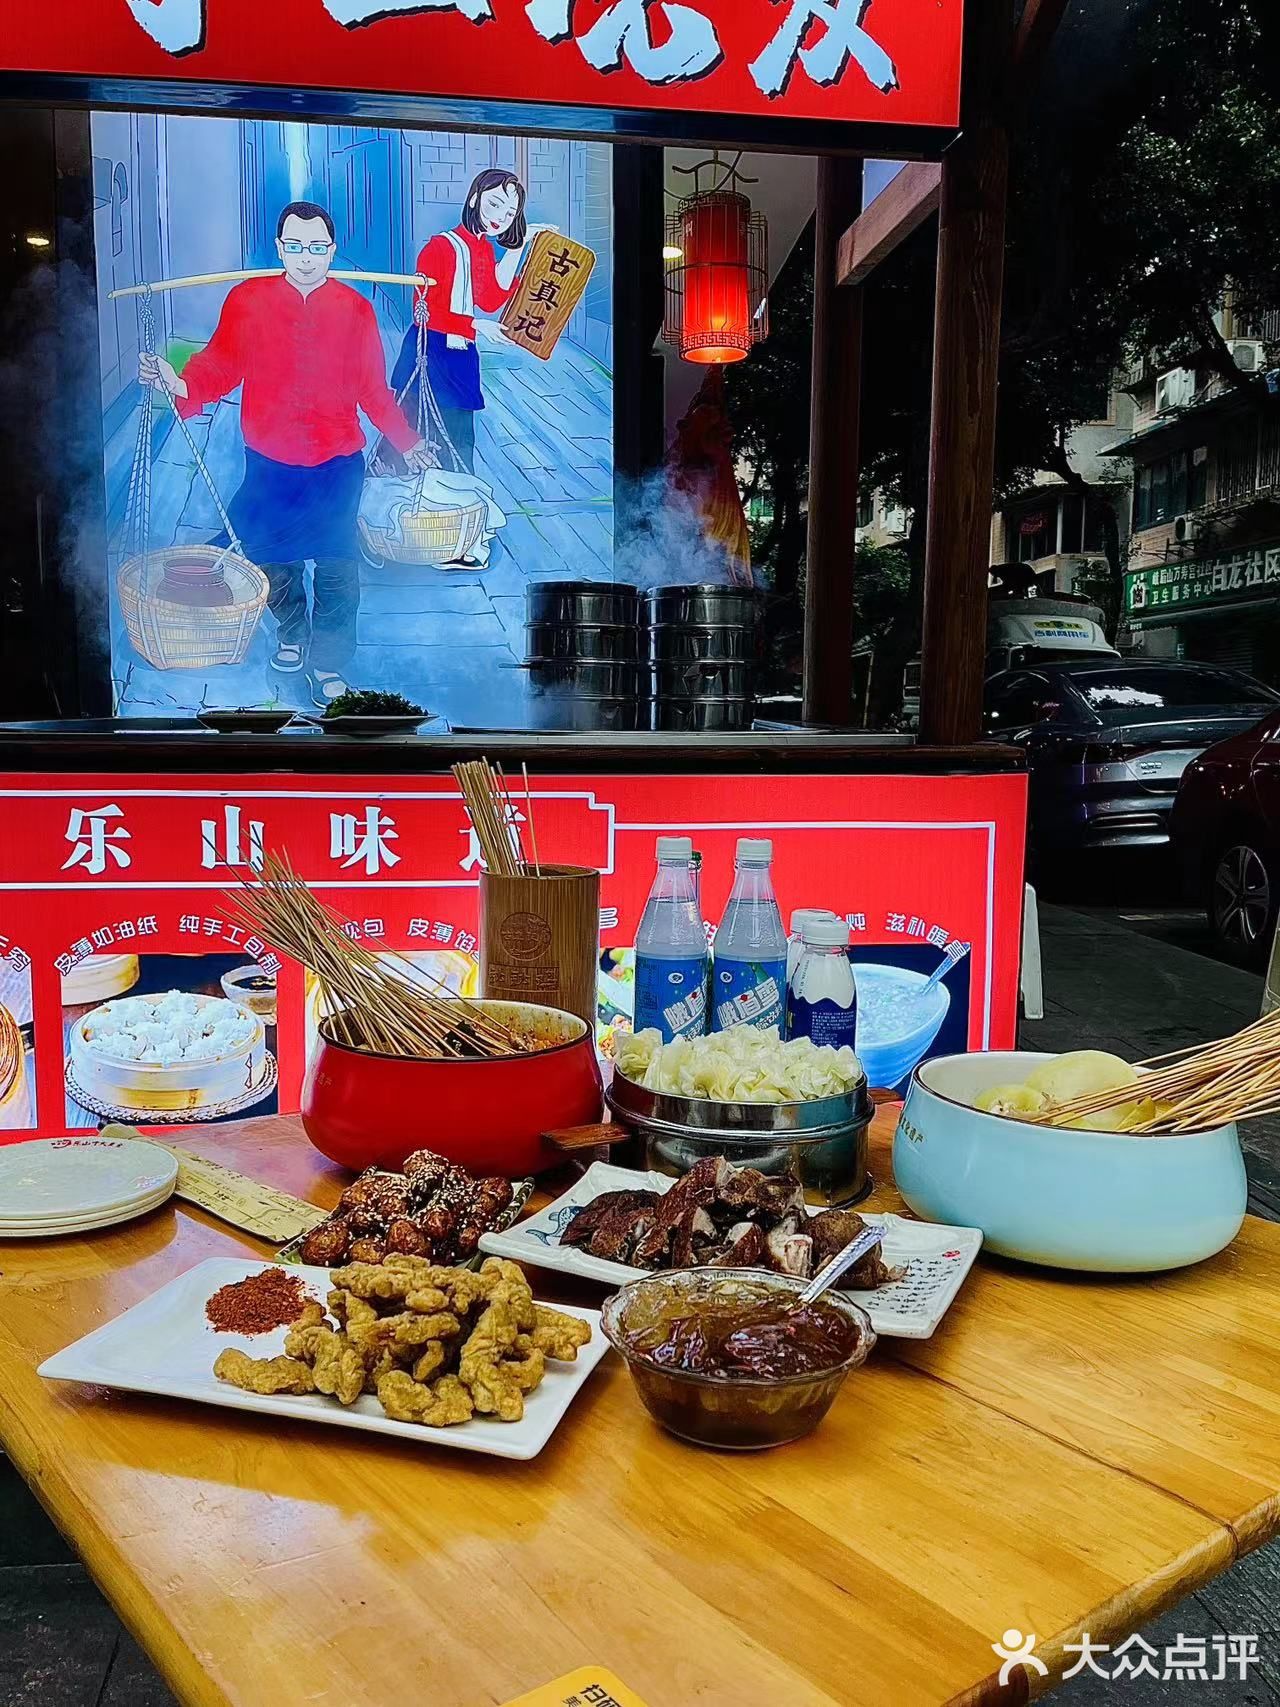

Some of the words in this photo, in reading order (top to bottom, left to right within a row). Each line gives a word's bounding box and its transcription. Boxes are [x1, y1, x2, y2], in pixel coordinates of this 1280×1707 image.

[513, 247, 580, 342] 古真记
[1152, 580, 1215, 605] 卫生服务中心
[53, 915, 159, 976] 皮薄如油纸
[178, 914, 283, 975] 纯手工包制
[884, 912, 967, 962] 滋补暖胃
[662, 976, 707, 1028] 峨眉
